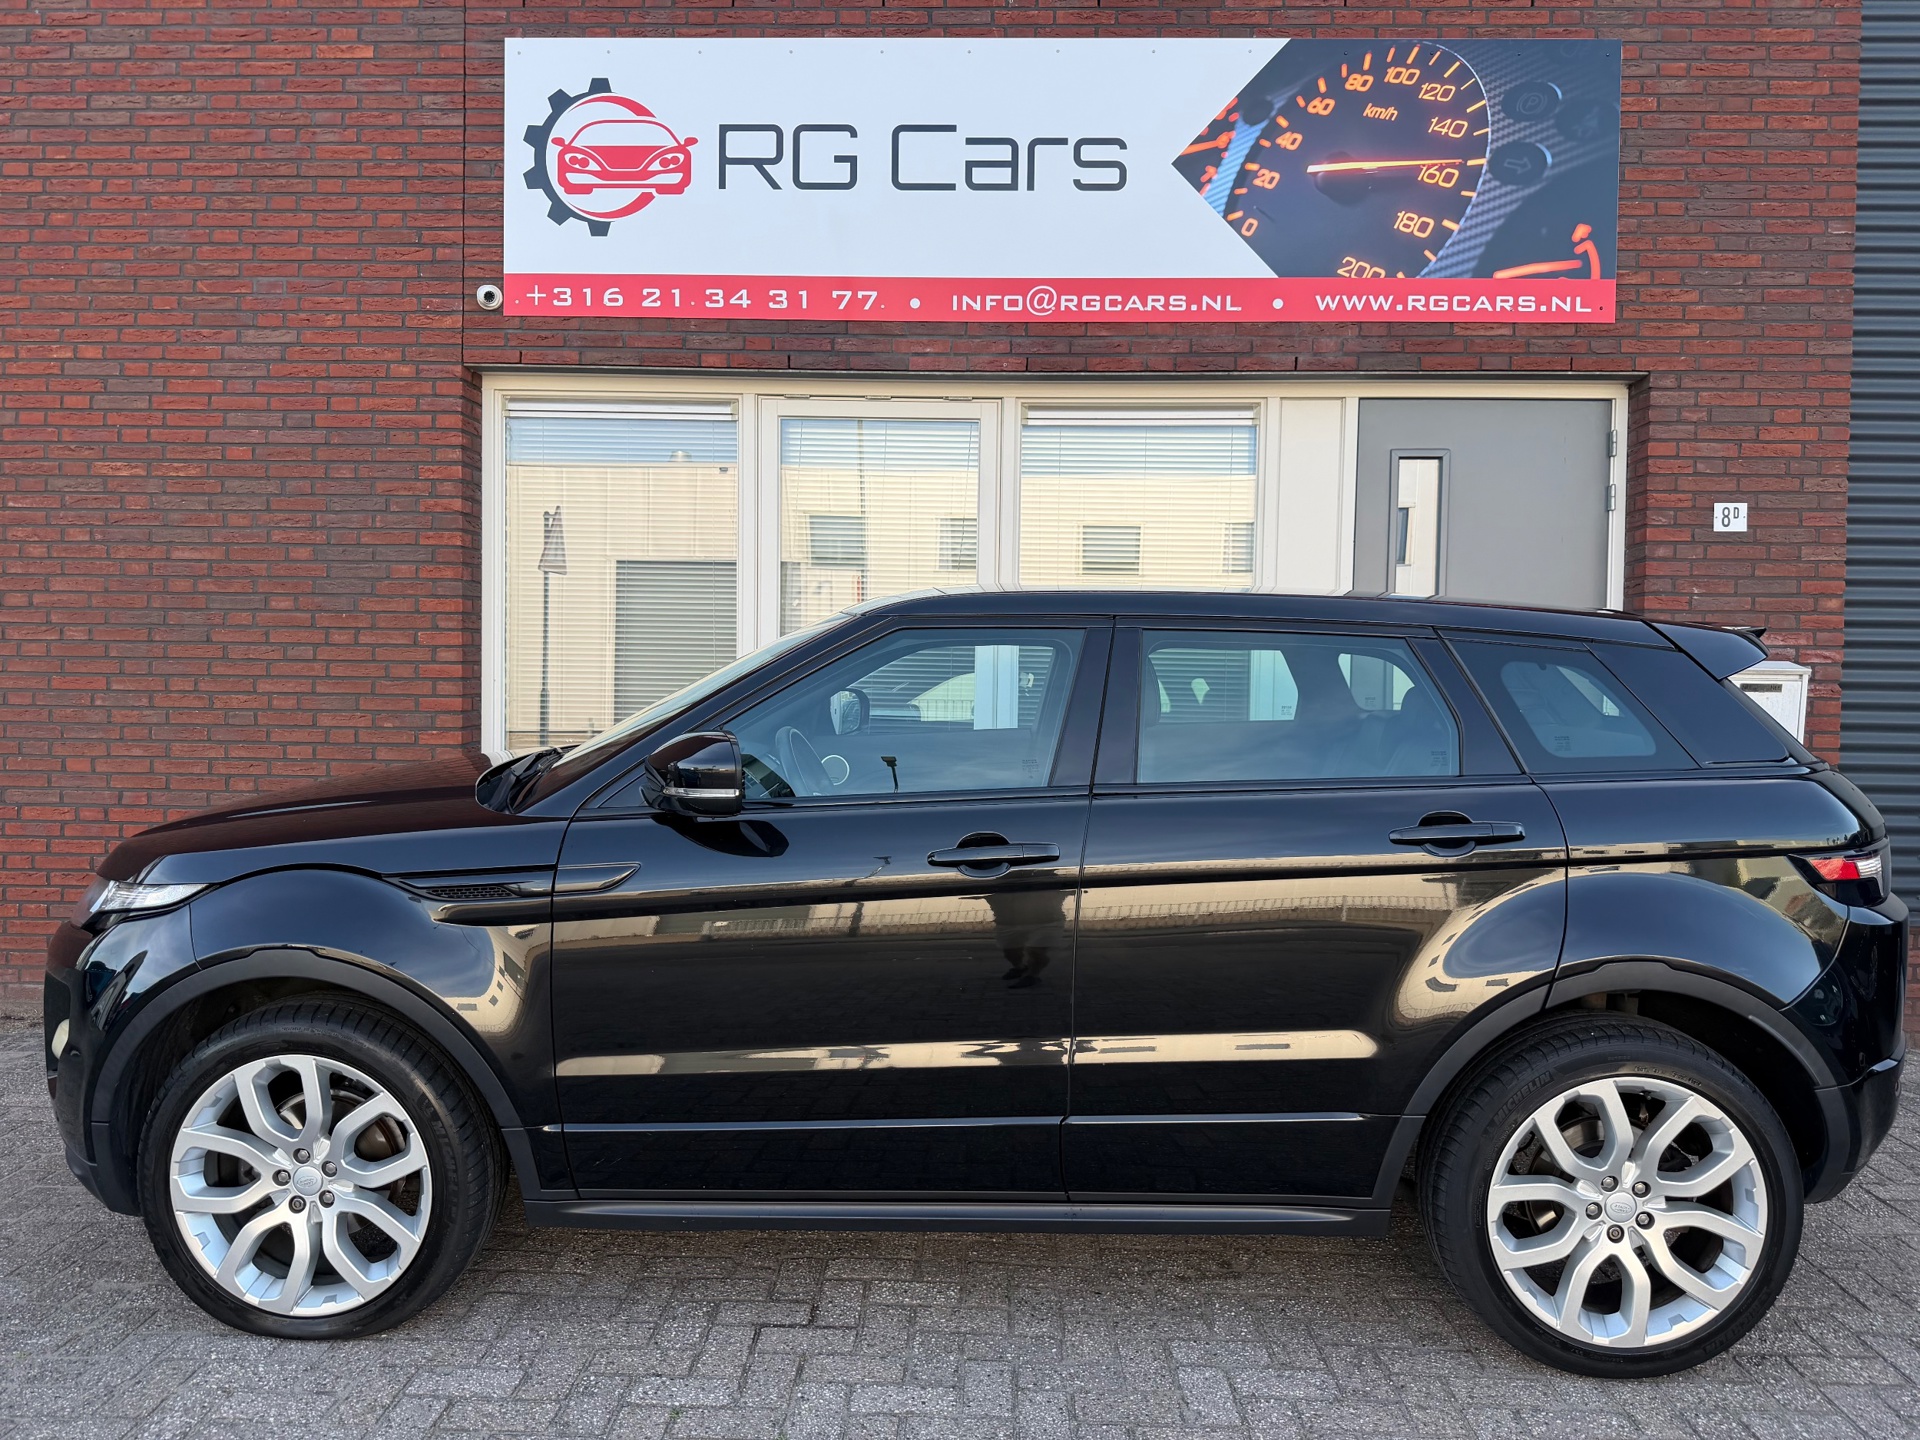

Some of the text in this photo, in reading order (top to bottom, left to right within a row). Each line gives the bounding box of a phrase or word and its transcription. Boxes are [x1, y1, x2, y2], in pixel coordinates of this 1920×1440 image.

[1344, 73, 1374, 92] 80
[1384, 66, 1420, 85] 100
[1418, 83, 1456, 102] 120
[1306, 96, 1336, 116] 60
[1363, 103, 1399, 121] km/h
[1428, 117, 1468, 138] 140
[1275, 131, 1303, 150] 40
[718, 123, 1128, 192] RG Cars
[1252, 168, 1280, 189] 20
[1417, 165, 1460, 188] 160
[1241, 218, 1258, 237] 0
[1394, 211, 1435, 238] 180
[526, 285, 624, 307] +316
[705, 288, 752, 309] 34
[768, 289, 807, 309] 31
[832, 290, 878, 310] 77
[952, 285, 1242, 316] INFO@RGCARS.NL
[1315, 294, 1592, 313] WWW.RGCARS.NL
